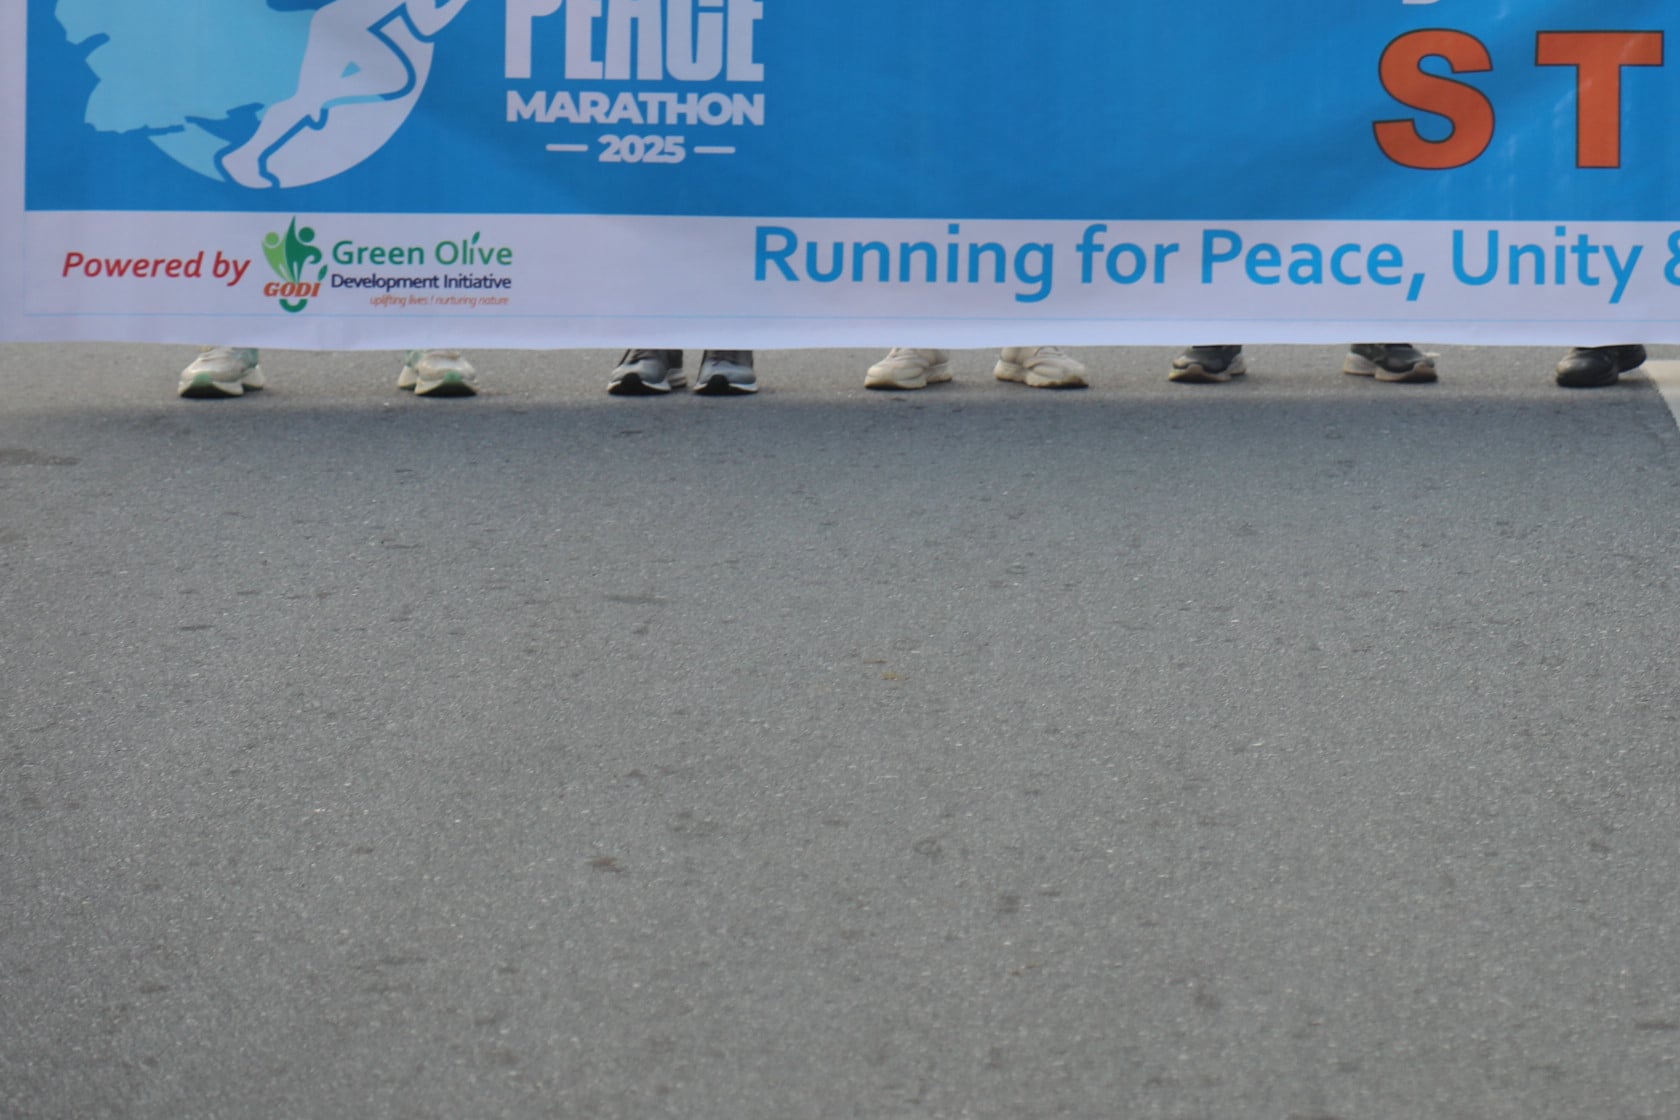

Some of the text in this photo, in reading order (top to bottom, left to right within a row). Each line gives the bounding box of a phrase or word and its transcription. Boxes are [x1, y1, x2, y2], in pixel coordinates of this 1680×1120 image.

[506, 90, 765, 126] MARATHON
[598, 134, 686, 164] 2025
[332, 232, 513, 266] Green Olive
[755, 224, 1054, 304] Running
[1076, 224, 1180, 285] for
[1202, 229, 1426, 302] Peace,
[1452, 226, 1643, 304] Unity
[62, 251, 251, 286] Powered by
[331, 274, 512, 293] Development Initiative
[263, 280, 322, 298] GODI
[480, 295, 510, 306] nature
